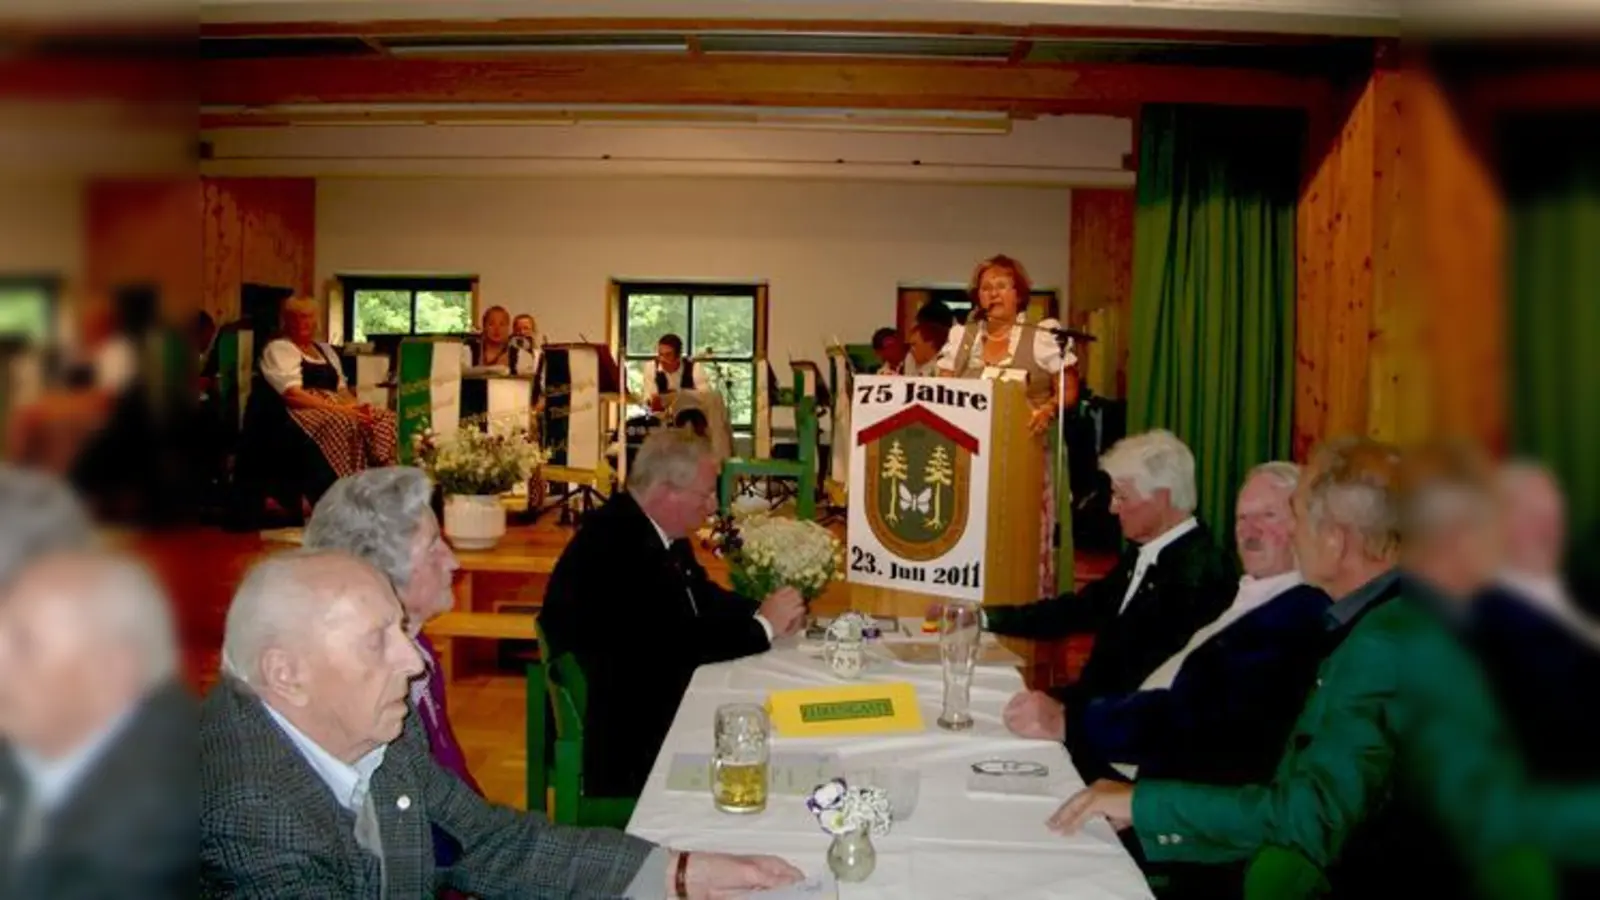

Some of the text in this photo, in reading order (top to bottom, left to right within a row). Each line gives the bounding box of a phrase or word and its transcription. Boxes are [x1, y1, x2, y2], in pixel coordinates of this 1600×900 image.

[857, 382, 988, 411] 75 Jahre
[851, 545, 980, 588] 23. Juli 2011
